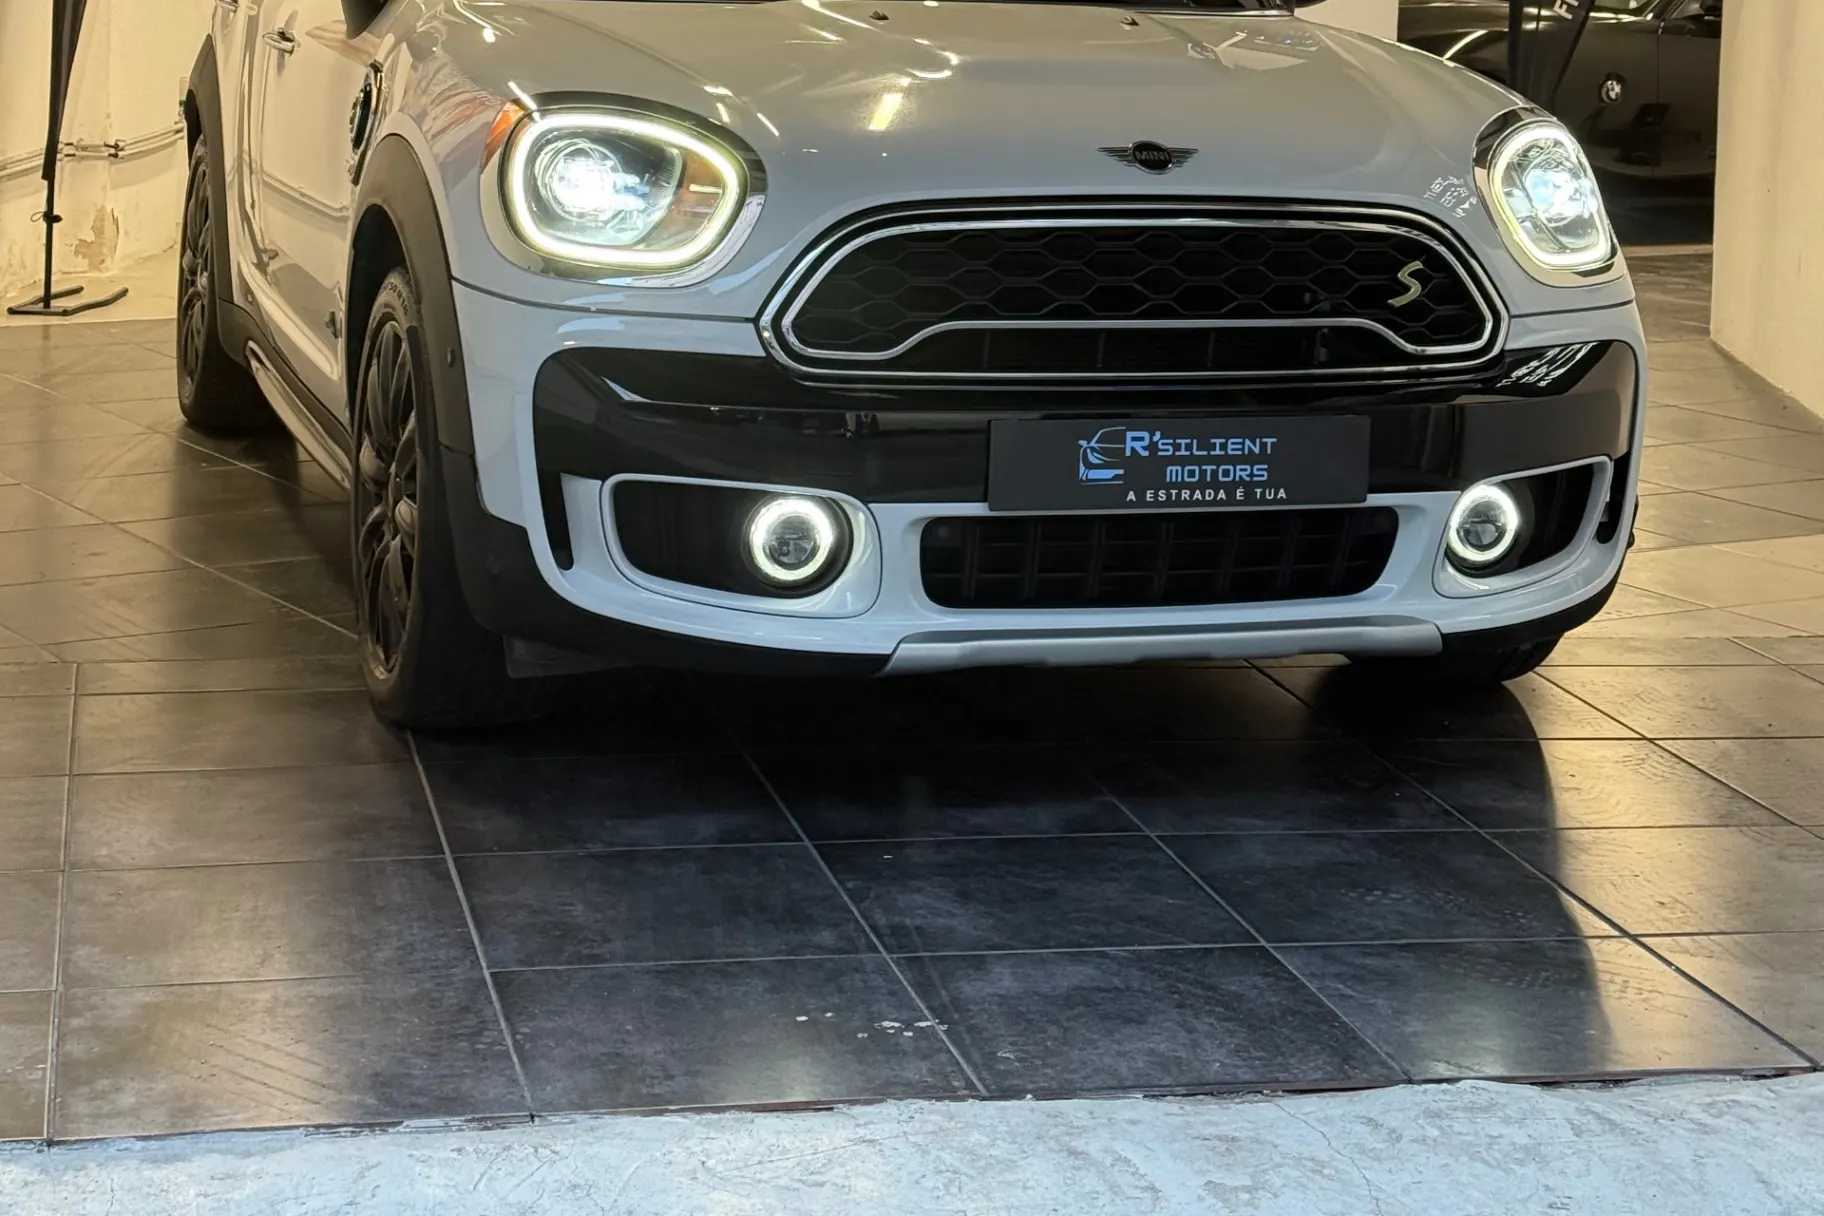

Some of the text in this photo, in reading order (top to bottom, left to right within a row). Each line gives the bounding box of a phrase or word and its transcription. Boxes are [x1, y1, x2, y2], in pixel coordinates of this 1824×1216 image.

[1134, 150, 1171, 161] MINI
[1387, 260, 1424, 308] S
[1125, 431, 1278, 457] R'SILIENT
[1166, 464, 1269, 483] MOTORS
[1126, 486, 1287, 502] A ESTRADA É TUA
